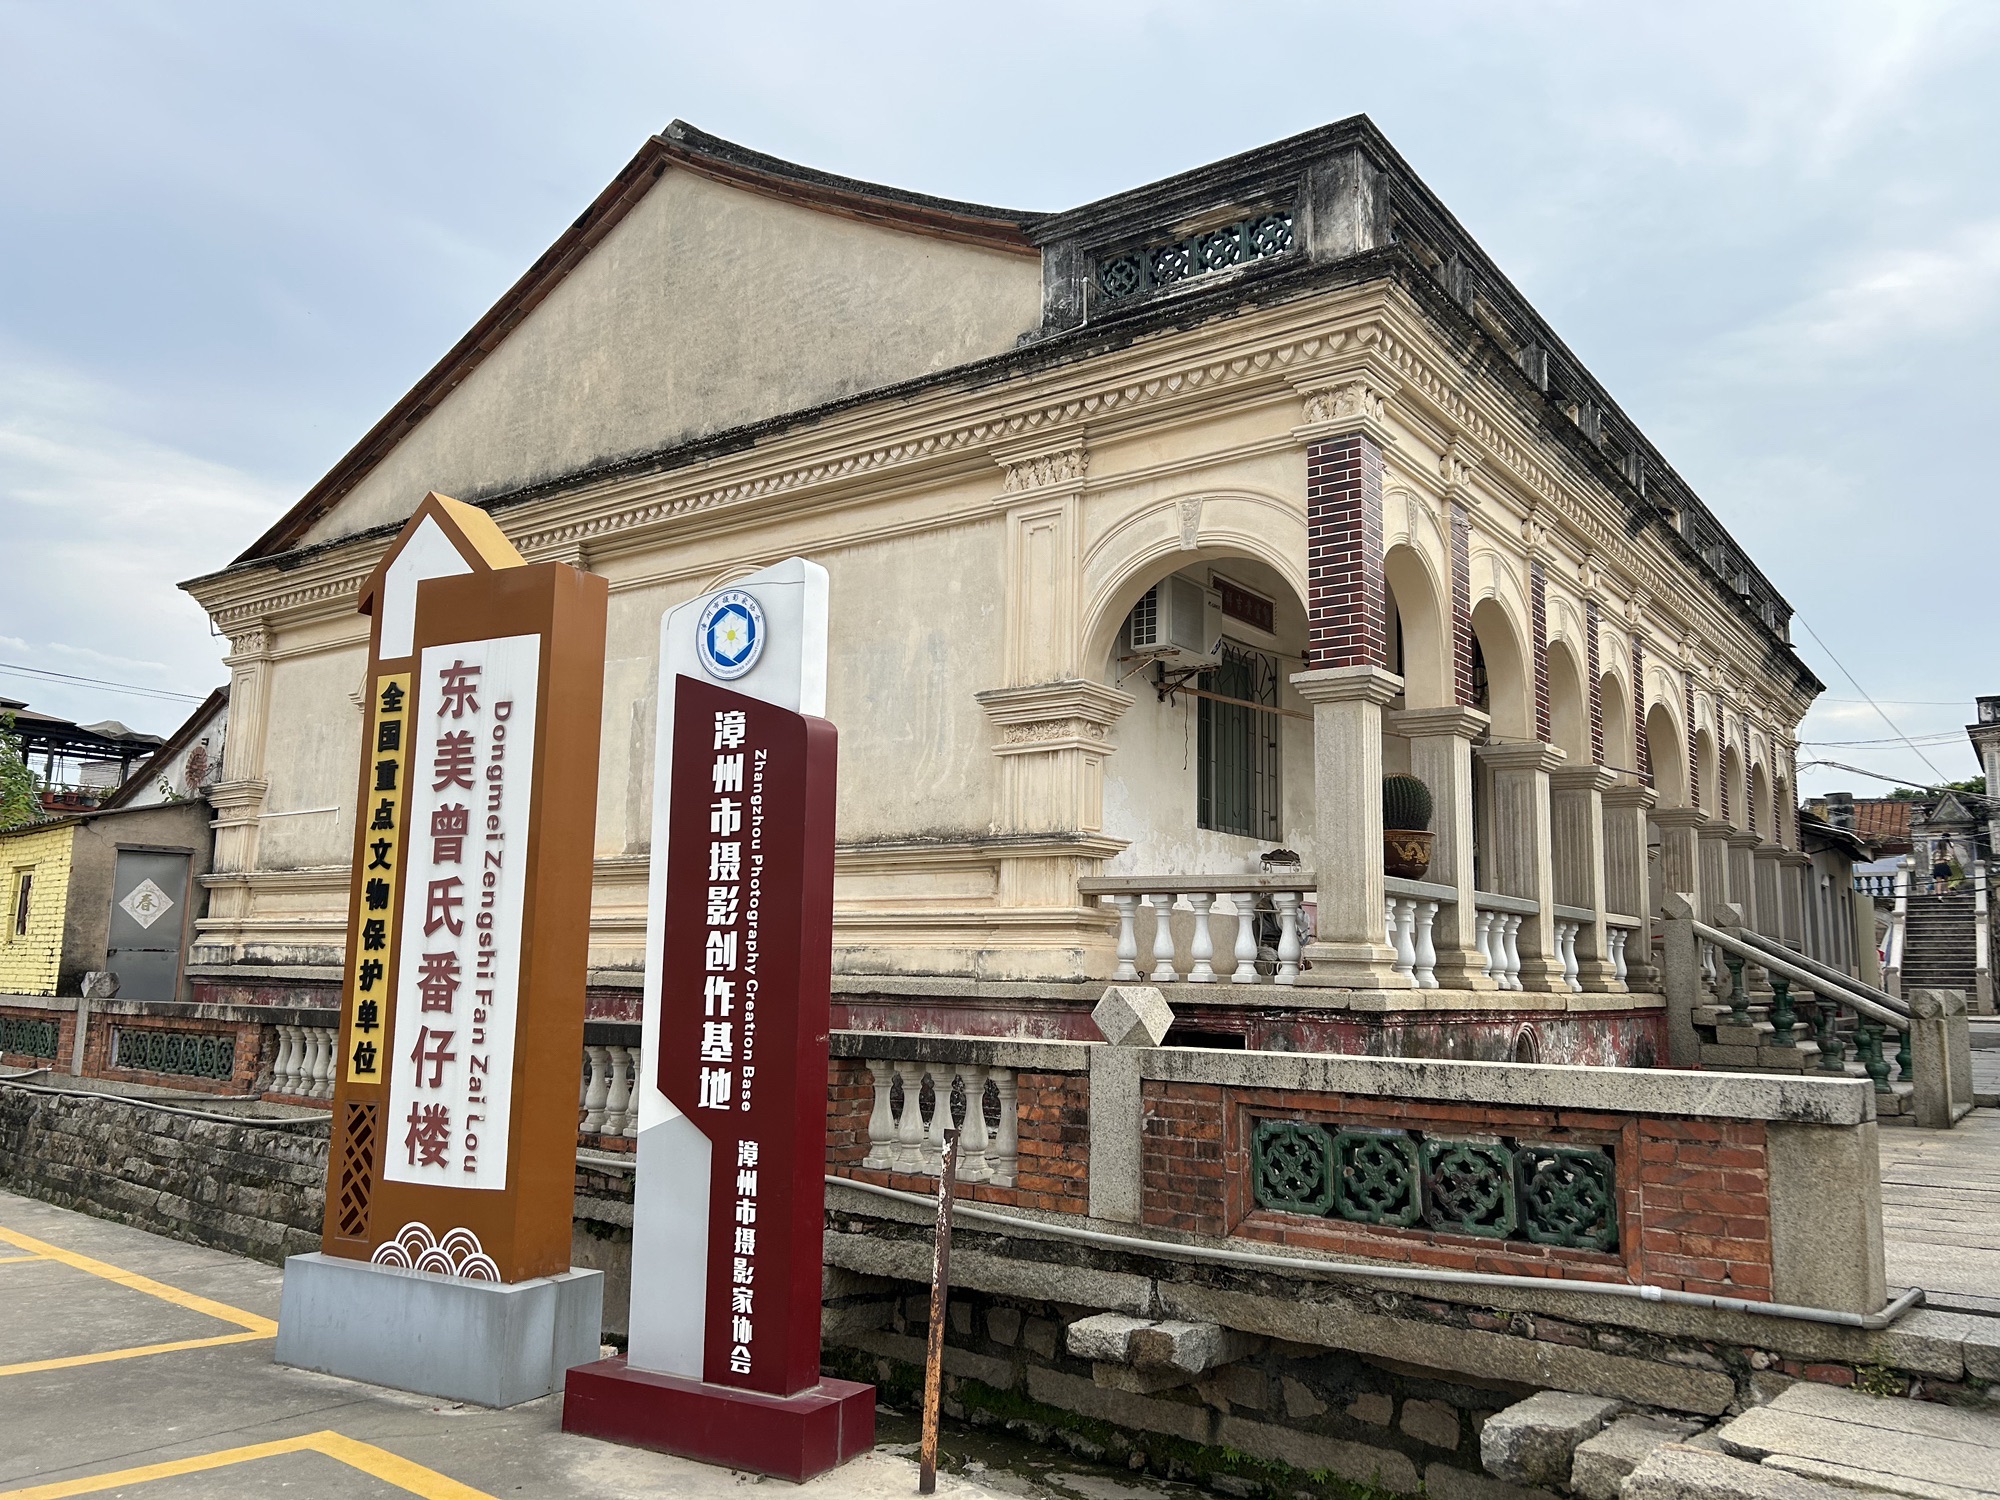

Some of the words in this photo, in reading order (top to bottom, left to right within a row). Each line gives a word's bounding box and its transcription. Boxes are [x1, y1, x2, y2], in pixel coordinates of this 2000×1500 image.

[486, 700, 513, 841] Dongmei
[750, 748, 767, 850] Zhangzhou
[136, 893, 158, 912] 春
[352, 681, 405, 1075] 全国重点文物保护单位
[404, 660, 482, 1169] 东美曾氏番仔楼
[476, 850, 503, 979] Zengshi
[698, 710, 746, 1110] 漳州市摄影创作基地
[744, 854, 763, 975] Photography
[472, 989, 494, 1045] Fan
[743, 979, 759, 1061] Creation
[468, 1054, 491, 1104] Zai
[741, 1065, 755, 1112] Base
[463, 1114, 486, 1174] Lou
[730, 1139, 759, 1375] 漳州市摄影家协会
